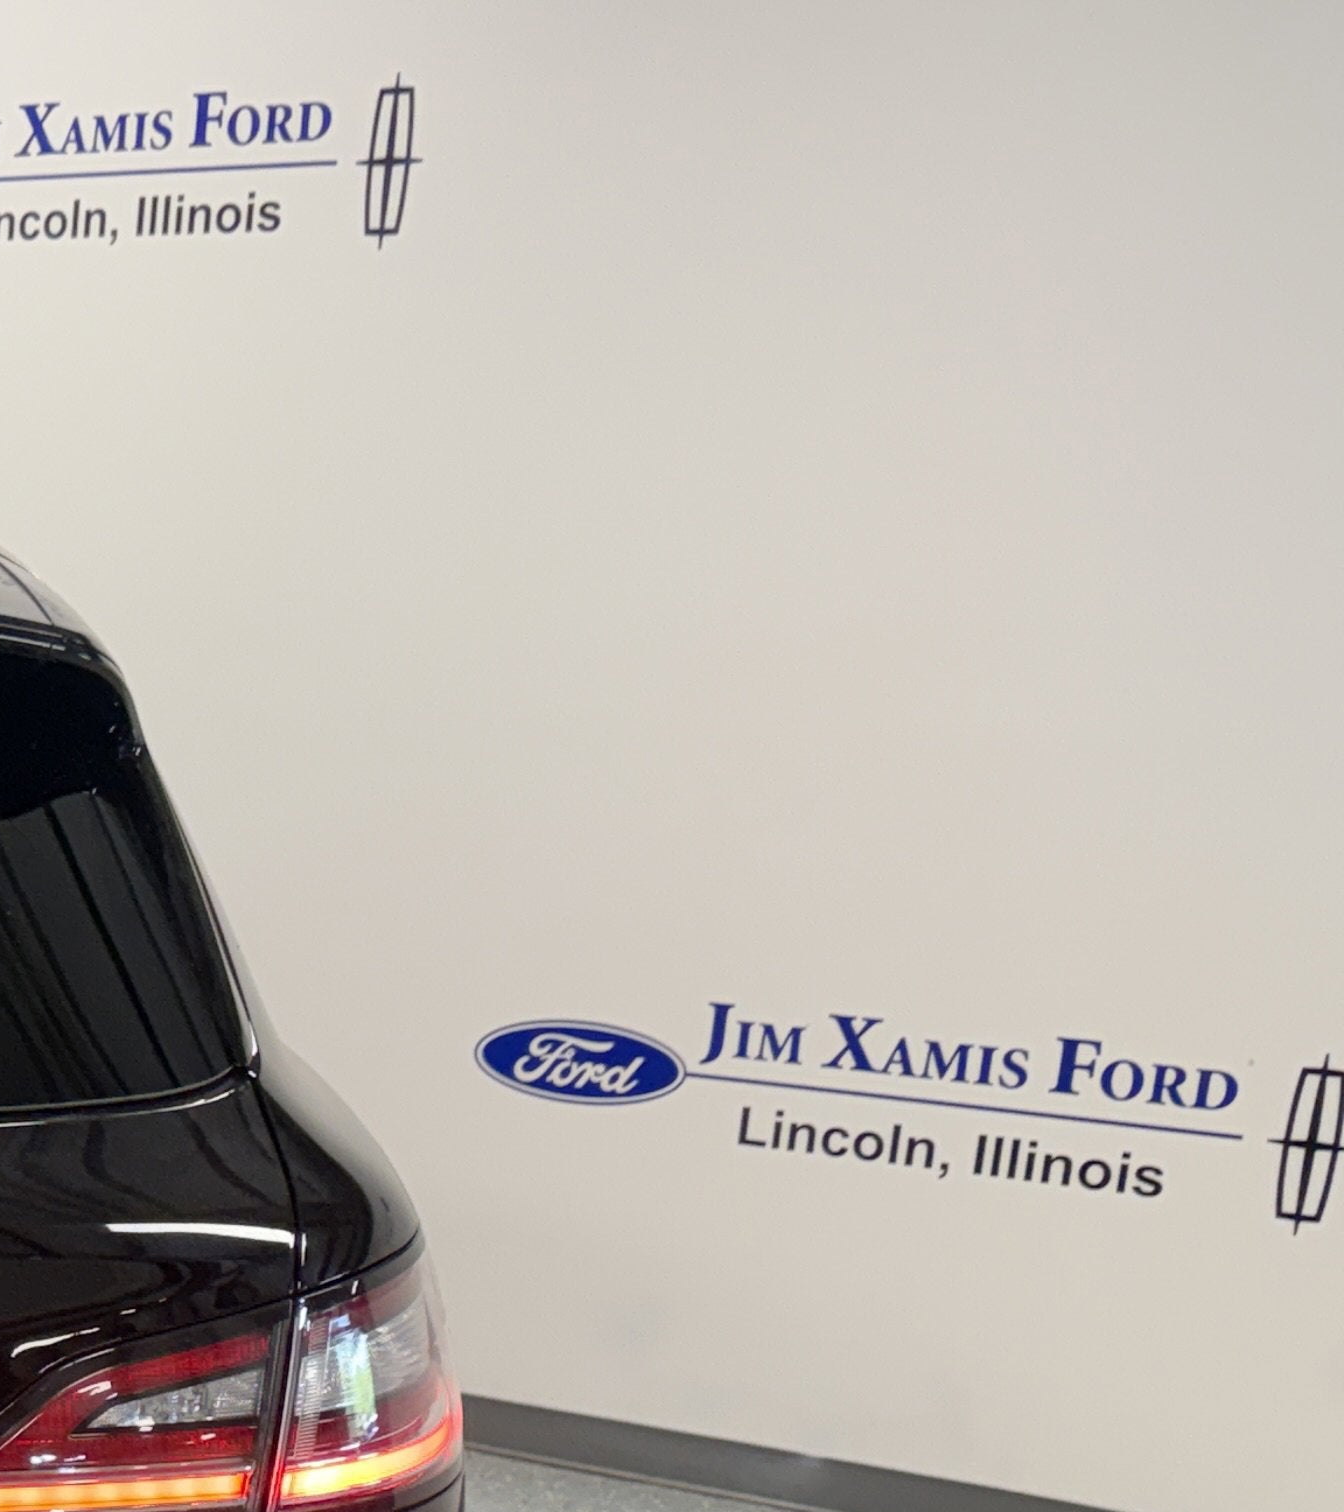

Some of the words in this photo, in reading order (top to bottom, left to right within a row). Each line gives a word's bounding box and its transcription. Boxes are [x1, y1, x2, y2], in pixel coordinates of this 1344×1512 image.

[13, 102, 174, 158] XAMIS
[189, 91, 332, 147] FORD
[135, 192, 281, 237] Illinois
[513, 1032, 639, 1094] Ford
[700, 1001, 809, 1065] JIM
[827, 1013, 1030, 1090] XAMIS
[1049, 1036, 1240, 1111] FORD
[737, 1106, 951, 1179] Lincoln,
[971, 1134, 1166, 1198] Illinois
